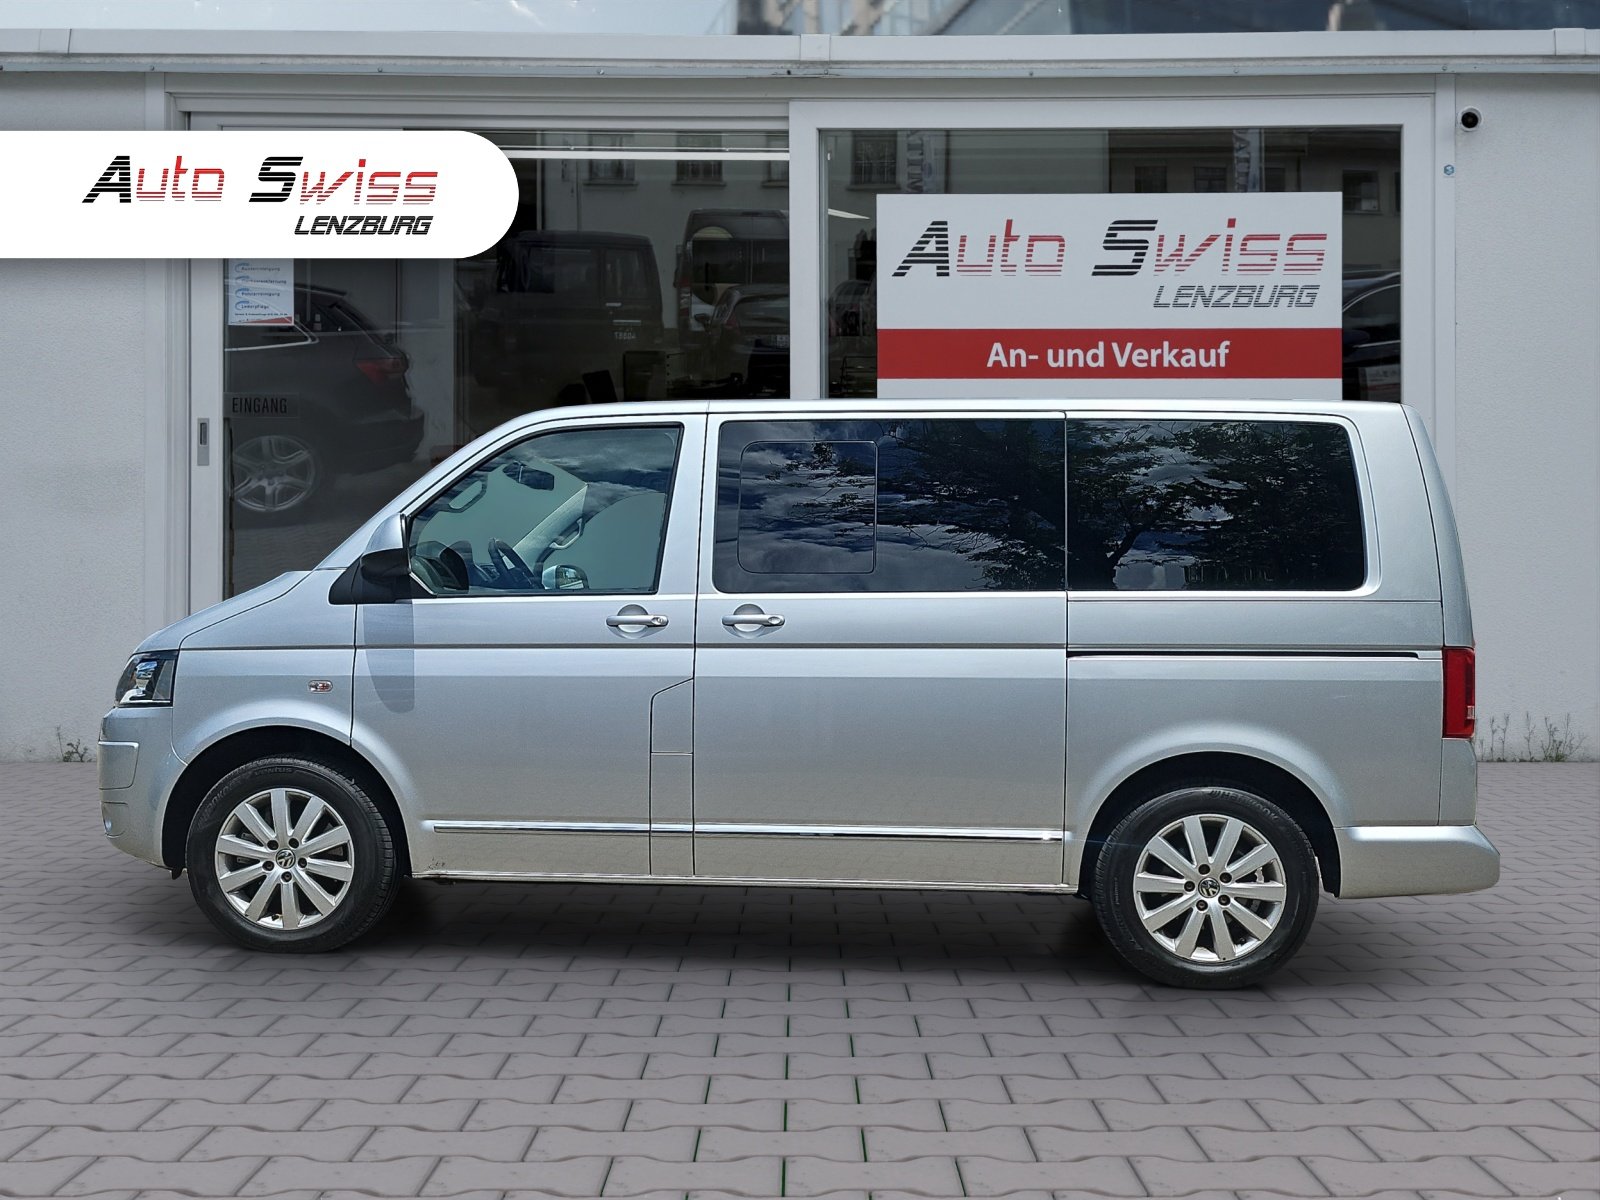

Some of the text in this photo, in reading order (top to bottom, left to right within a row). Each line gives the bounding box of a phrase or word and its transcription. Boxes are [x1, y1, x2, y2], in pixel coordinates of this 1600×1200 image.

[892, 217, 1328, 277] Auto Swiss
[1153, 284, 1320, 308] LENZBURG
[987, 340, 1231, 368] An- und Verkauf
[232, 397, 287, 414] EINGANG
